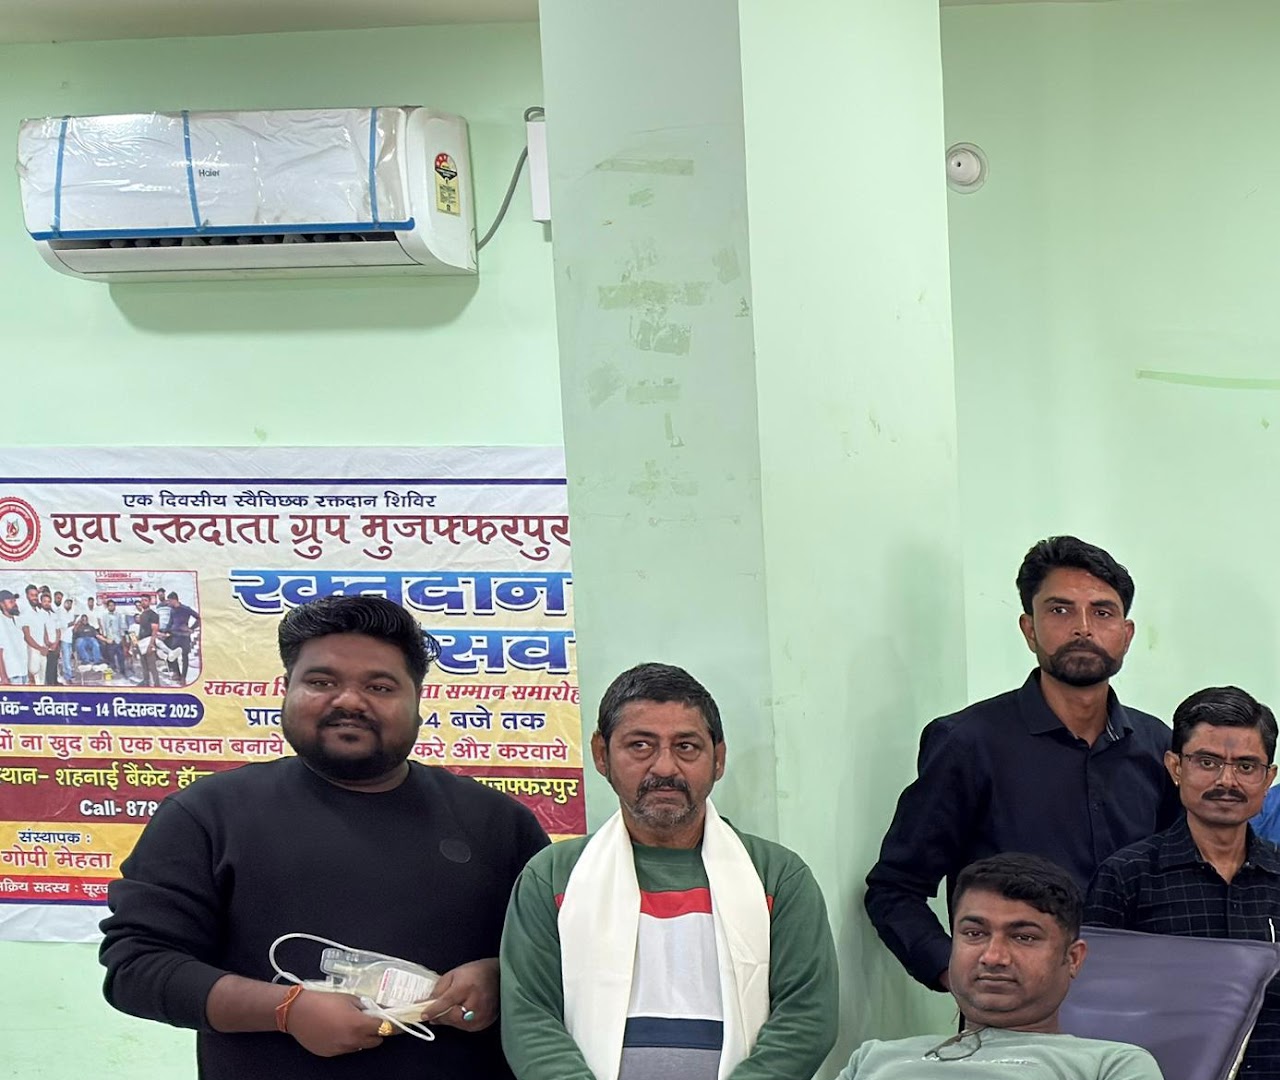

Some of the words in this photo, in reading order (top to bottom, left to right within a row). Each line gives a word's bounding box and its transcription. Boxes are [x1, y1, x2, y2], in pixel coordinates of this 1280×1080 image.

[198, 169, 221, 178] Haier
[122, 494, 153, 507] एक
[159, 490, 227, 507] दिवसीय
[315, 495, 378, 508] रक्तदान
[384, 491, 437, 508] शिविर
[50, 514, 122, 558] युवा
[130, 514, 280, 546] रक्तदाता
[289, 514, 351, 560] ग्रुप
[360, 515, 571, 561] मुजफ्फरपुर
[204, 680, 270, 697] रक्तदान
[446, 683, 507, 700] सम्मान
[33, 696, 79, 716] रविवार
[96, 703, 109, 717] 14
[113, 696, 166, 718] दिसम्बर
[169, 703, 198, 719] 2025
[425, 713, 441, 729] 4
[450, 705, 493, 730] बजे
[501, 712, 546, 730] तक
[19, 736, 43, 750] ना
[48, 736, 82, 757] खुद
[88, 730, 112, 752] की
[120, 735, 153, 753] एक
[160, 737, 222, 754] पहचान
[229, 733, 285, 755] बनाये
[453, 737, 491, 760] और
[497, 738, 568, 761] करवाये
[55, 761, 119, 790] शहनाई
[124, 761, 170, 788] बैंकेट
[80, 800, 122, 817] Call-
[19, 828, 81, 843] संस्थापक
[1, 845, 48, 868] गोपी
[57, 846, 112, 869] मेहता
[33, 882, 70, 893] सदस्य
